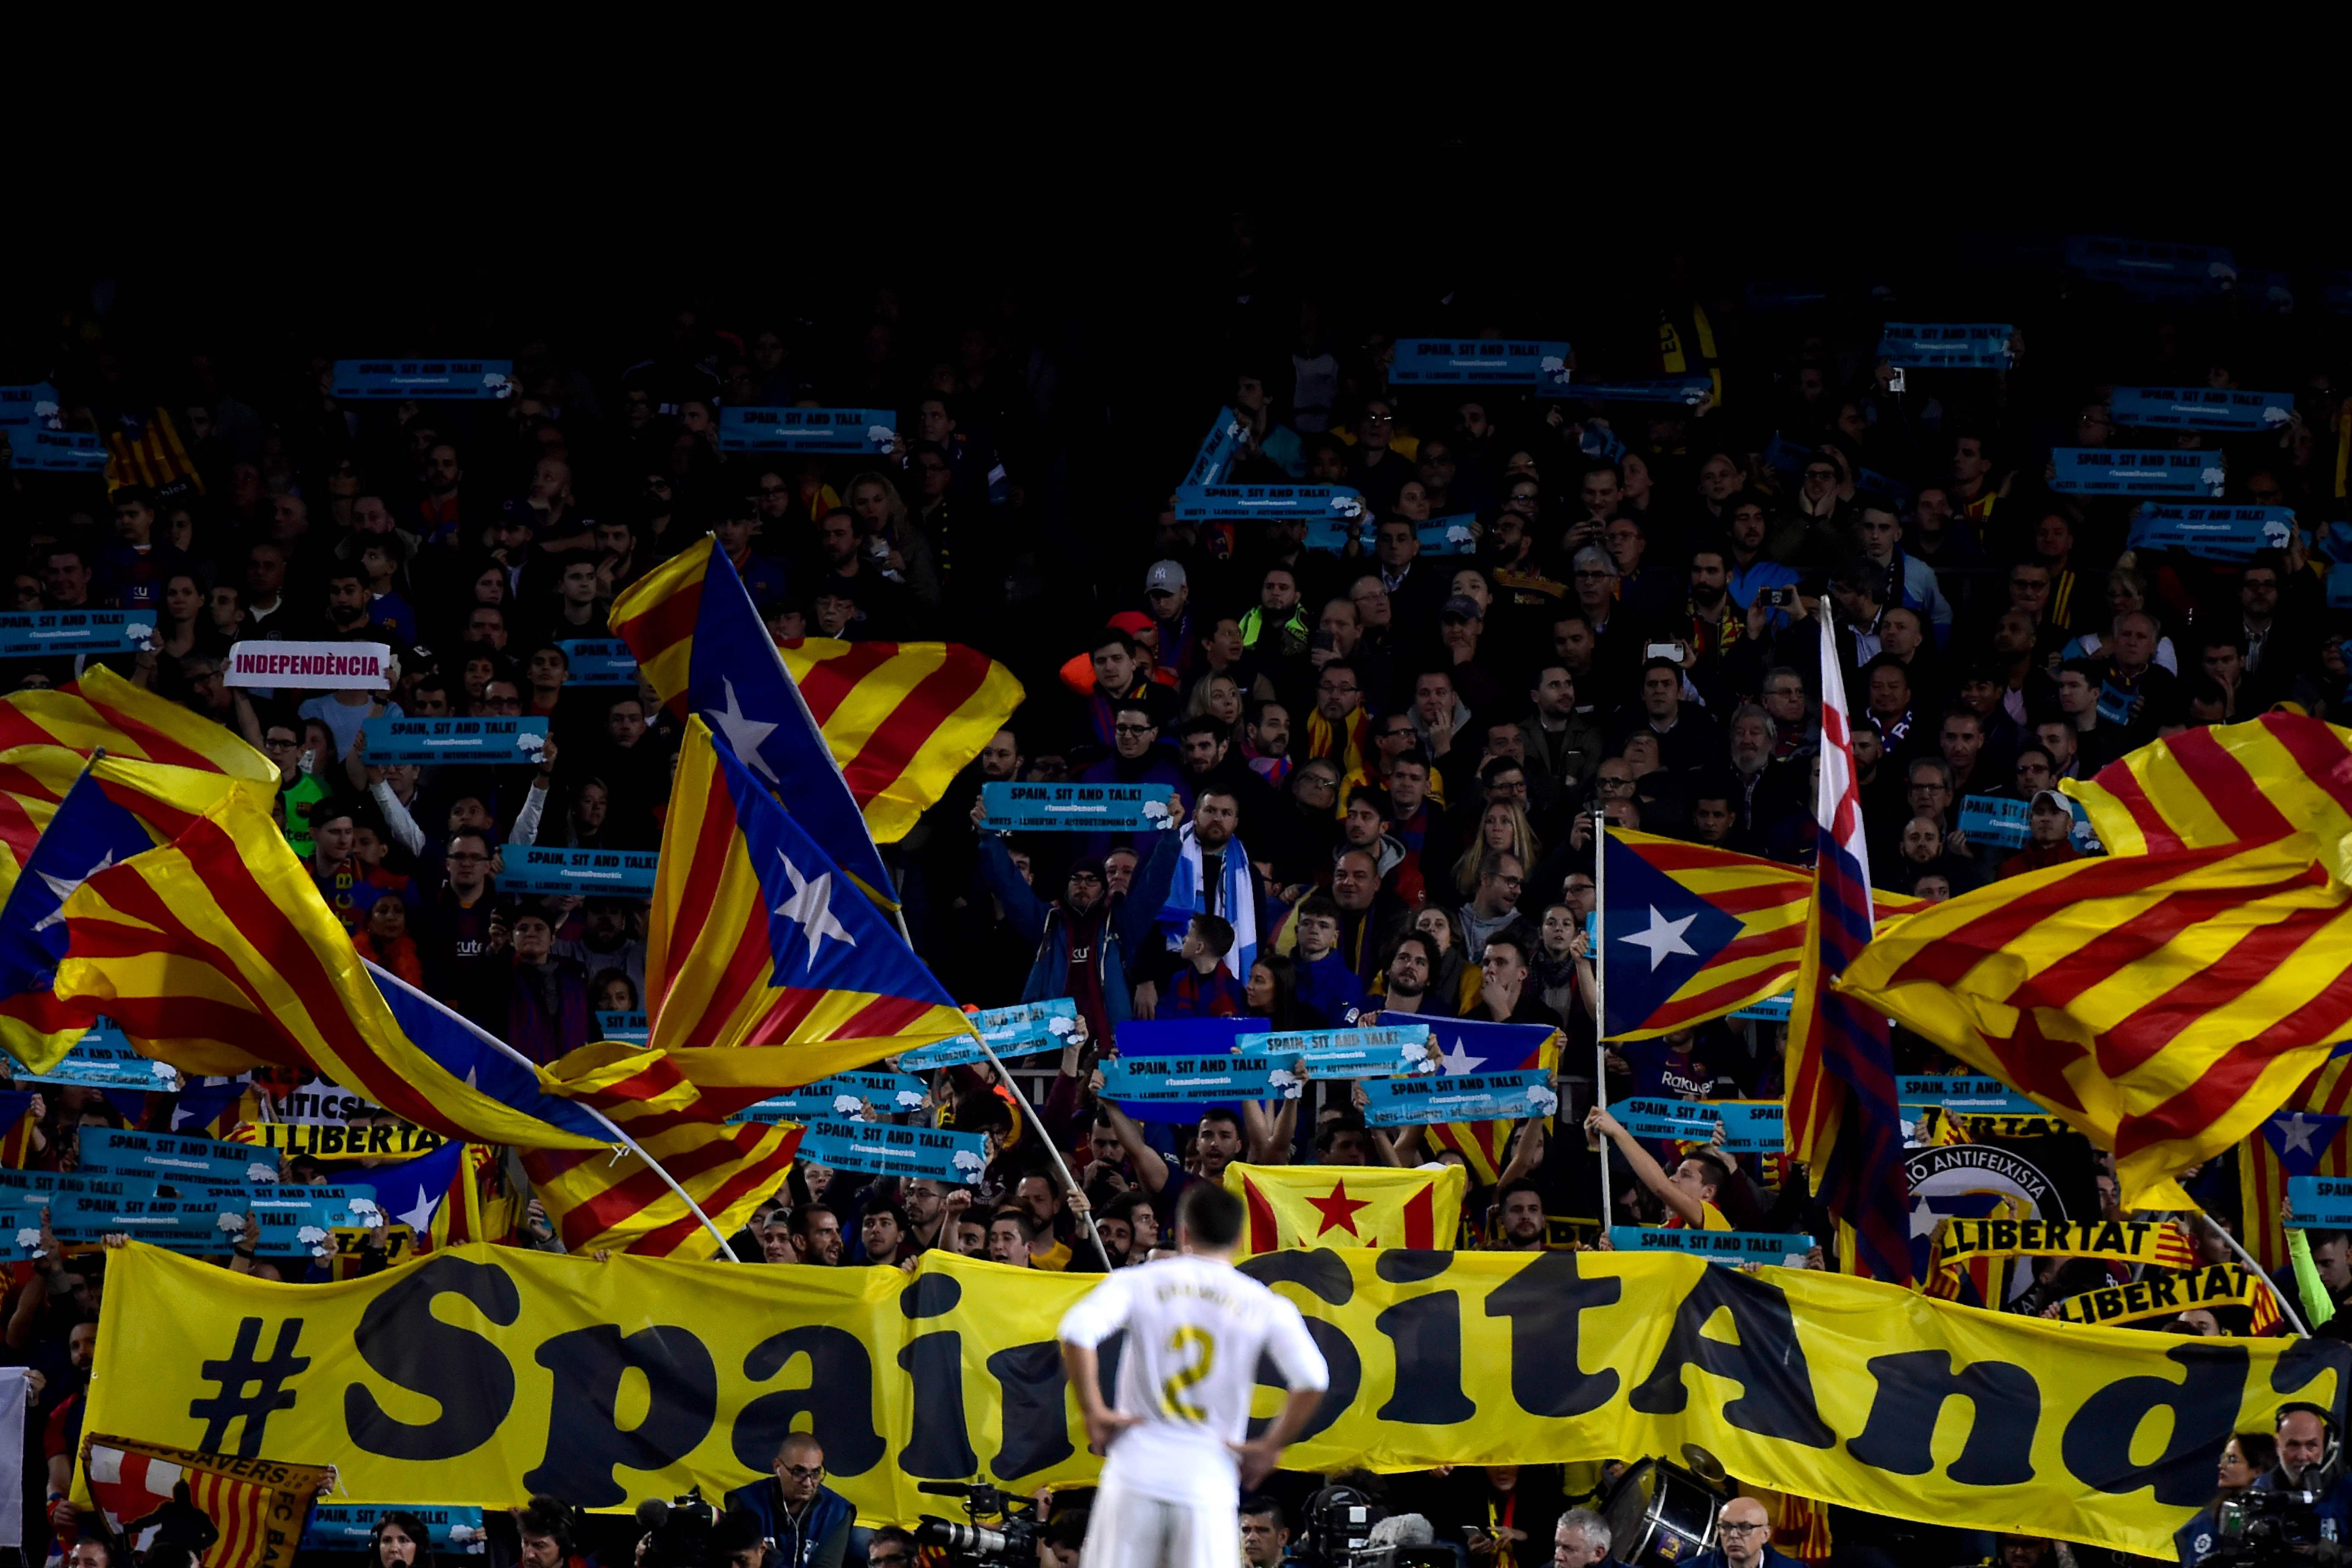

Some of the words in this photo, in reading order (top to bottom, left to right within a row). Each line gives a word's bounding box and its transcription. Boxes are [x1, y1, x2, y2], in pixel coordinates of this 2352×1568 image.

[1418, 343, 1454, 355] SPAIN,
[1459, 344, 1475, 355] SIT
[1480, 344, 1504, 355] AND
[1508, 345, 1539, 356] TALK!
[359, 364, 396, 374] SPAIN,
[402, 364, 417, 373] SIT
[422, 364, 446, 373] AND
[451, 364, 482, 373] TALK!
[2140, 389, 2177, 402] SPAIN,
[2182, 391, 2199, 402] SIT
[2203, 392, 2229, 403] AND
[2233, 394, 2264, 406] TALK!
[744, 412, 780, 425] SPAIN,
[785, 412, 801, 424] SIT
[806, 413, 830, 425] AND
[2077, 453, 2114, 466] SPAIN,
[2119, 454, 2136, 466] SIT
[2140, 455, 2165, 466] AND
[2170, 455, 2200, 468] TALK!
[1205, 488, 1243, 498] SPAIN,
[1269, 489, 1294, 497] AND
[1298, 489, 1329, 497] TALK!
[40, 615, 56, 626] SIT
[61, 615, 86, 625] AND
[92, 614, 125, 625] TALK!
[574, 644, 612, 656] SPAIN,
[236, 652, 380, 676] INDEPENDÈNCIA
[391, 722, 429, 735] SPAIN,
[434, 723, 451, 734] SIT
[455, 723, 480, 735] AND
[485, 722, 517, 734] TALK!
[1010, 787, 1051, 802] SPAIN,
[1055, 788, 1074, 800] SIT
[1078, 788, 1104, 800] AND
[1108, 789, 1142, 800] TALK!
[527, 851, 566, 866] SPAIN,
[571, 854, 590, 866] SIT
[593, 855, 620, 867] AND
[624, 857, 656, 870] TALK!
[629, 1015, 647, 1028] AN
[1267, 1037, 1308, 1051] SPAIN,
[1312, 1035, 1329, 1048] SIT
[1335, 1034, 1360, 1047] AND
[1365, 1032, 1399, 1046] TALK!
[90, 1049, 113, 1059] AND
[1129, 1061, 1171, 1075] SPAIN,
[1176, 1061, 1195, 1073] SIT
[1199, 1059, 1226, 1072] AND
[1231, 1058, 1267, 1071] TALK!
[799, 1085, 833, 1097] TALK!
[1391, 1082, 1433, 1096] SPAIN,
[1436, 1079, 1454, 1092] SIT
[1459, 1077, 1484, 1090] AND
[1490, 1075, 1524, 1088] TALK!
[1905, 1081, 1947, 1095] SPAIN,
[1952, 1081, 1971, 1094] SIT
[1976, 1081, 2002, 1093] AND
[1629, 1101, 1671, 1117] SPAIN,
[1676, 1106, 1696, 1119] SIT
[266, 1124, 442, 1156] LLIBERTA
[816, 1122, 858, 1141] SPAIN,
[862, 1128, 882, 1141] SIT
[886, 1130, 914, 1145] AND
[918, 1133, 954, 1150] TALK!
[109, 1135, 152, 1152] SPAIN,
[155, 1139, 176, 1153] SIT
[180, 1142, 207, 1157] AND
[212, 1145, 248, 1162] TALK!
[1935, 1151, 2046, 1199] ANTIFEIXISTA
[207, 1188, 250, 1199] SPAIN,
[254, 1189, 273, 1198] SIT
[279, 1189, 305, 1198] AND
[309, 1188, 346, 1198] TALK!
[77, 1198, 120, 1214] SPAIN,
[125, 1201, 145, 1213] SIT
[149, 1202, 177, 1214] AND
[183, 1203, 218, 1214] TALK!
[261, 1213, 297, 1226] TALK!
[1641, 1233, 1684, 1249] SPAIN,
[1690, 1236, 1709, 1249] SIT
[1713, 1237, 1740, 1250] AND
[1746, 1239, 1782, 1252] TALK!
[1160, 1326, 1214, 1423] 2
[316, 1509, 351, 1524] PAIN,
[357, 1510, 375, 1522] SIT
